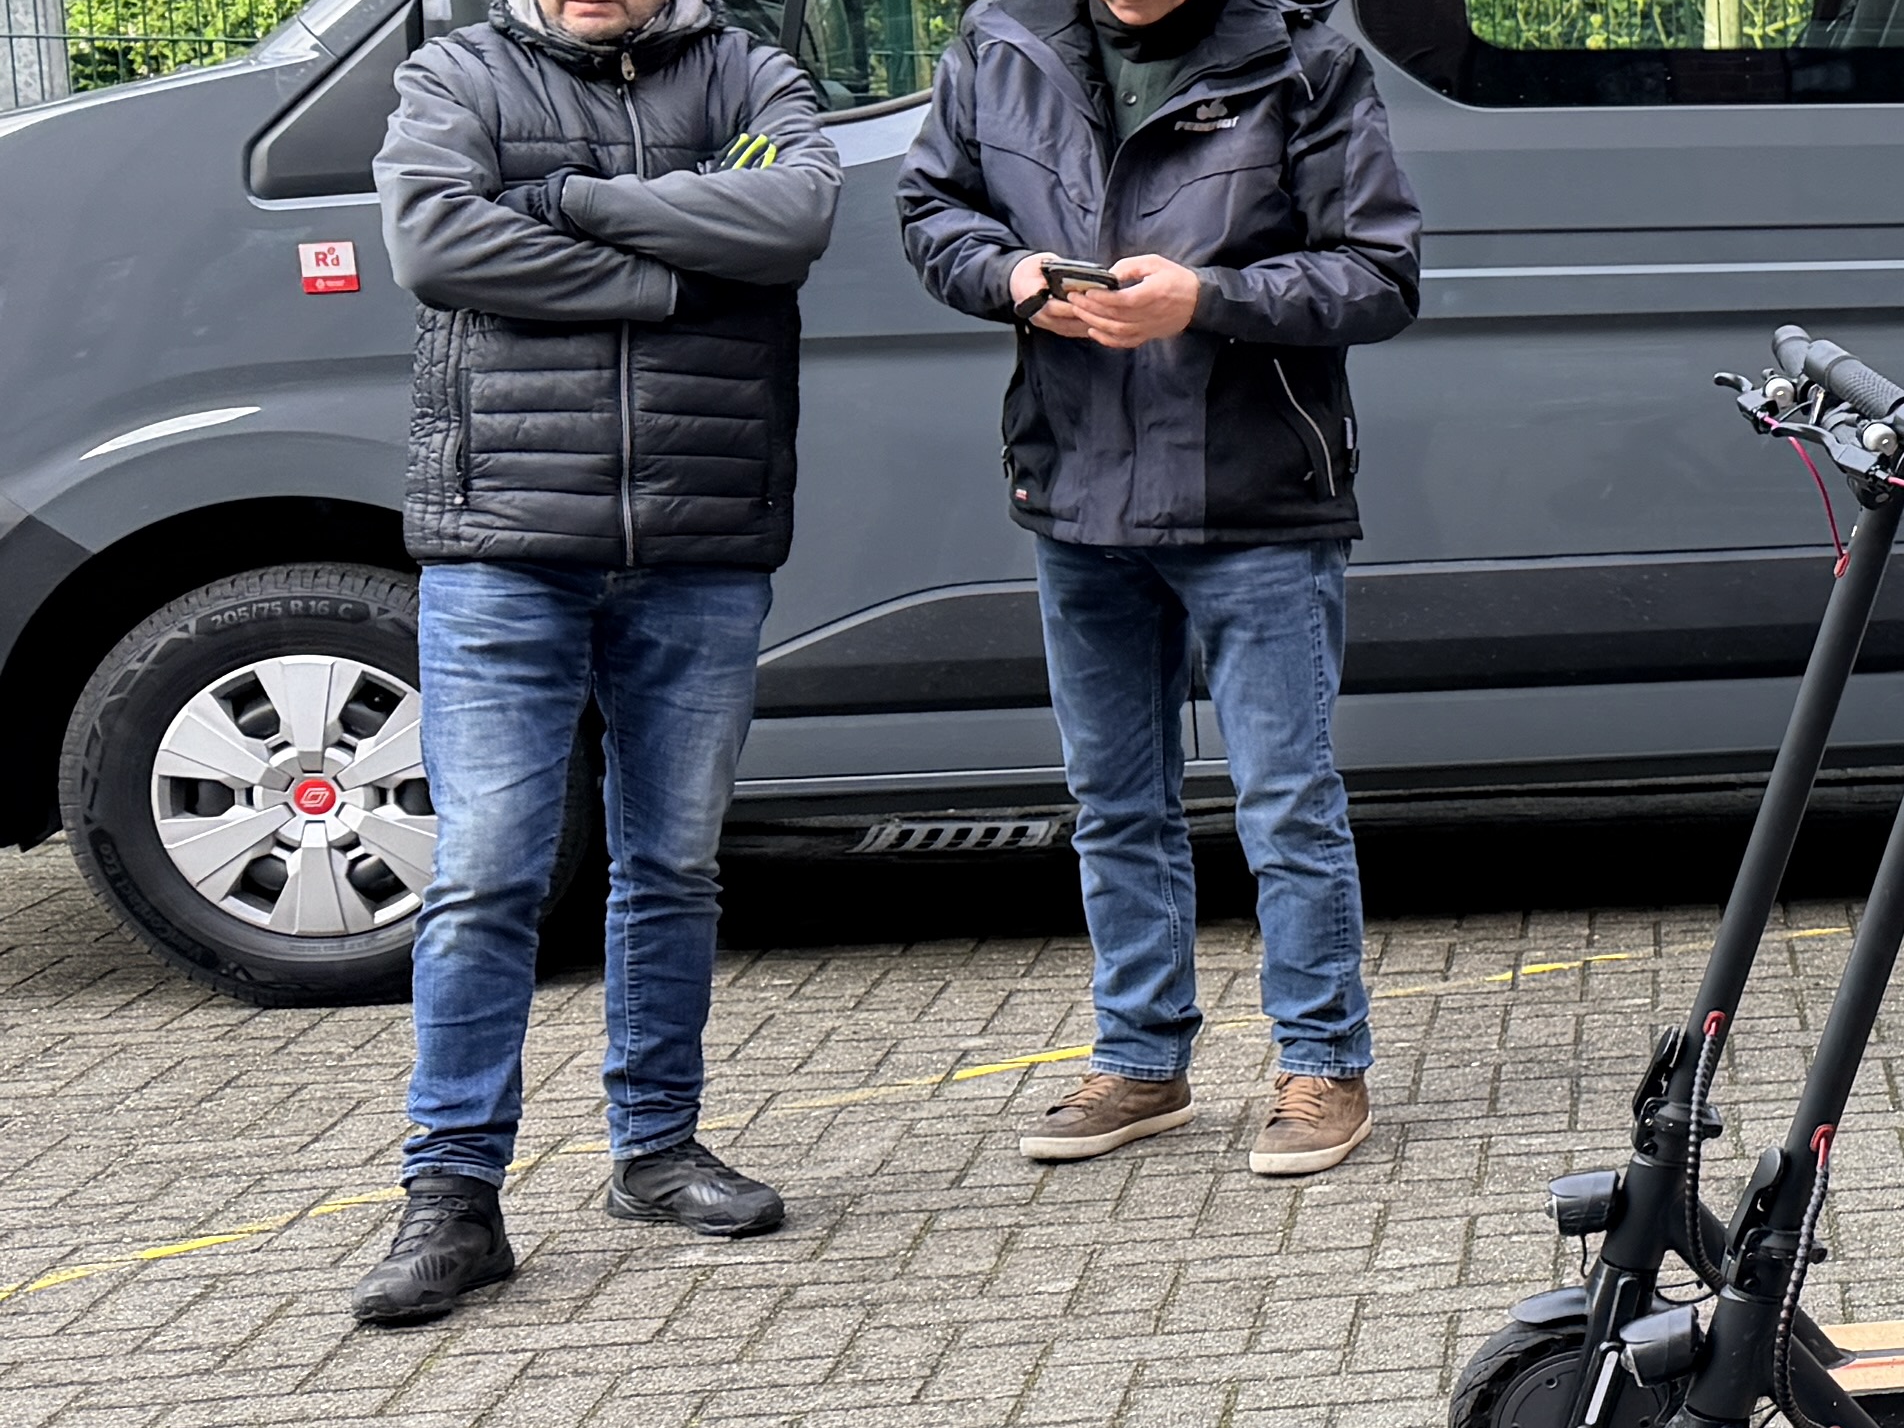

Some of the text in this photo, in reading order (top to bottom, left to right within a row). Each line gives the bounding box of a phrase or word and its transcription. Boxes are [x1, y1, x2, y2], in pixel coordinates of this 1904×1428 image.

[211, 600, 353, 630] 205/75 R 16 C
